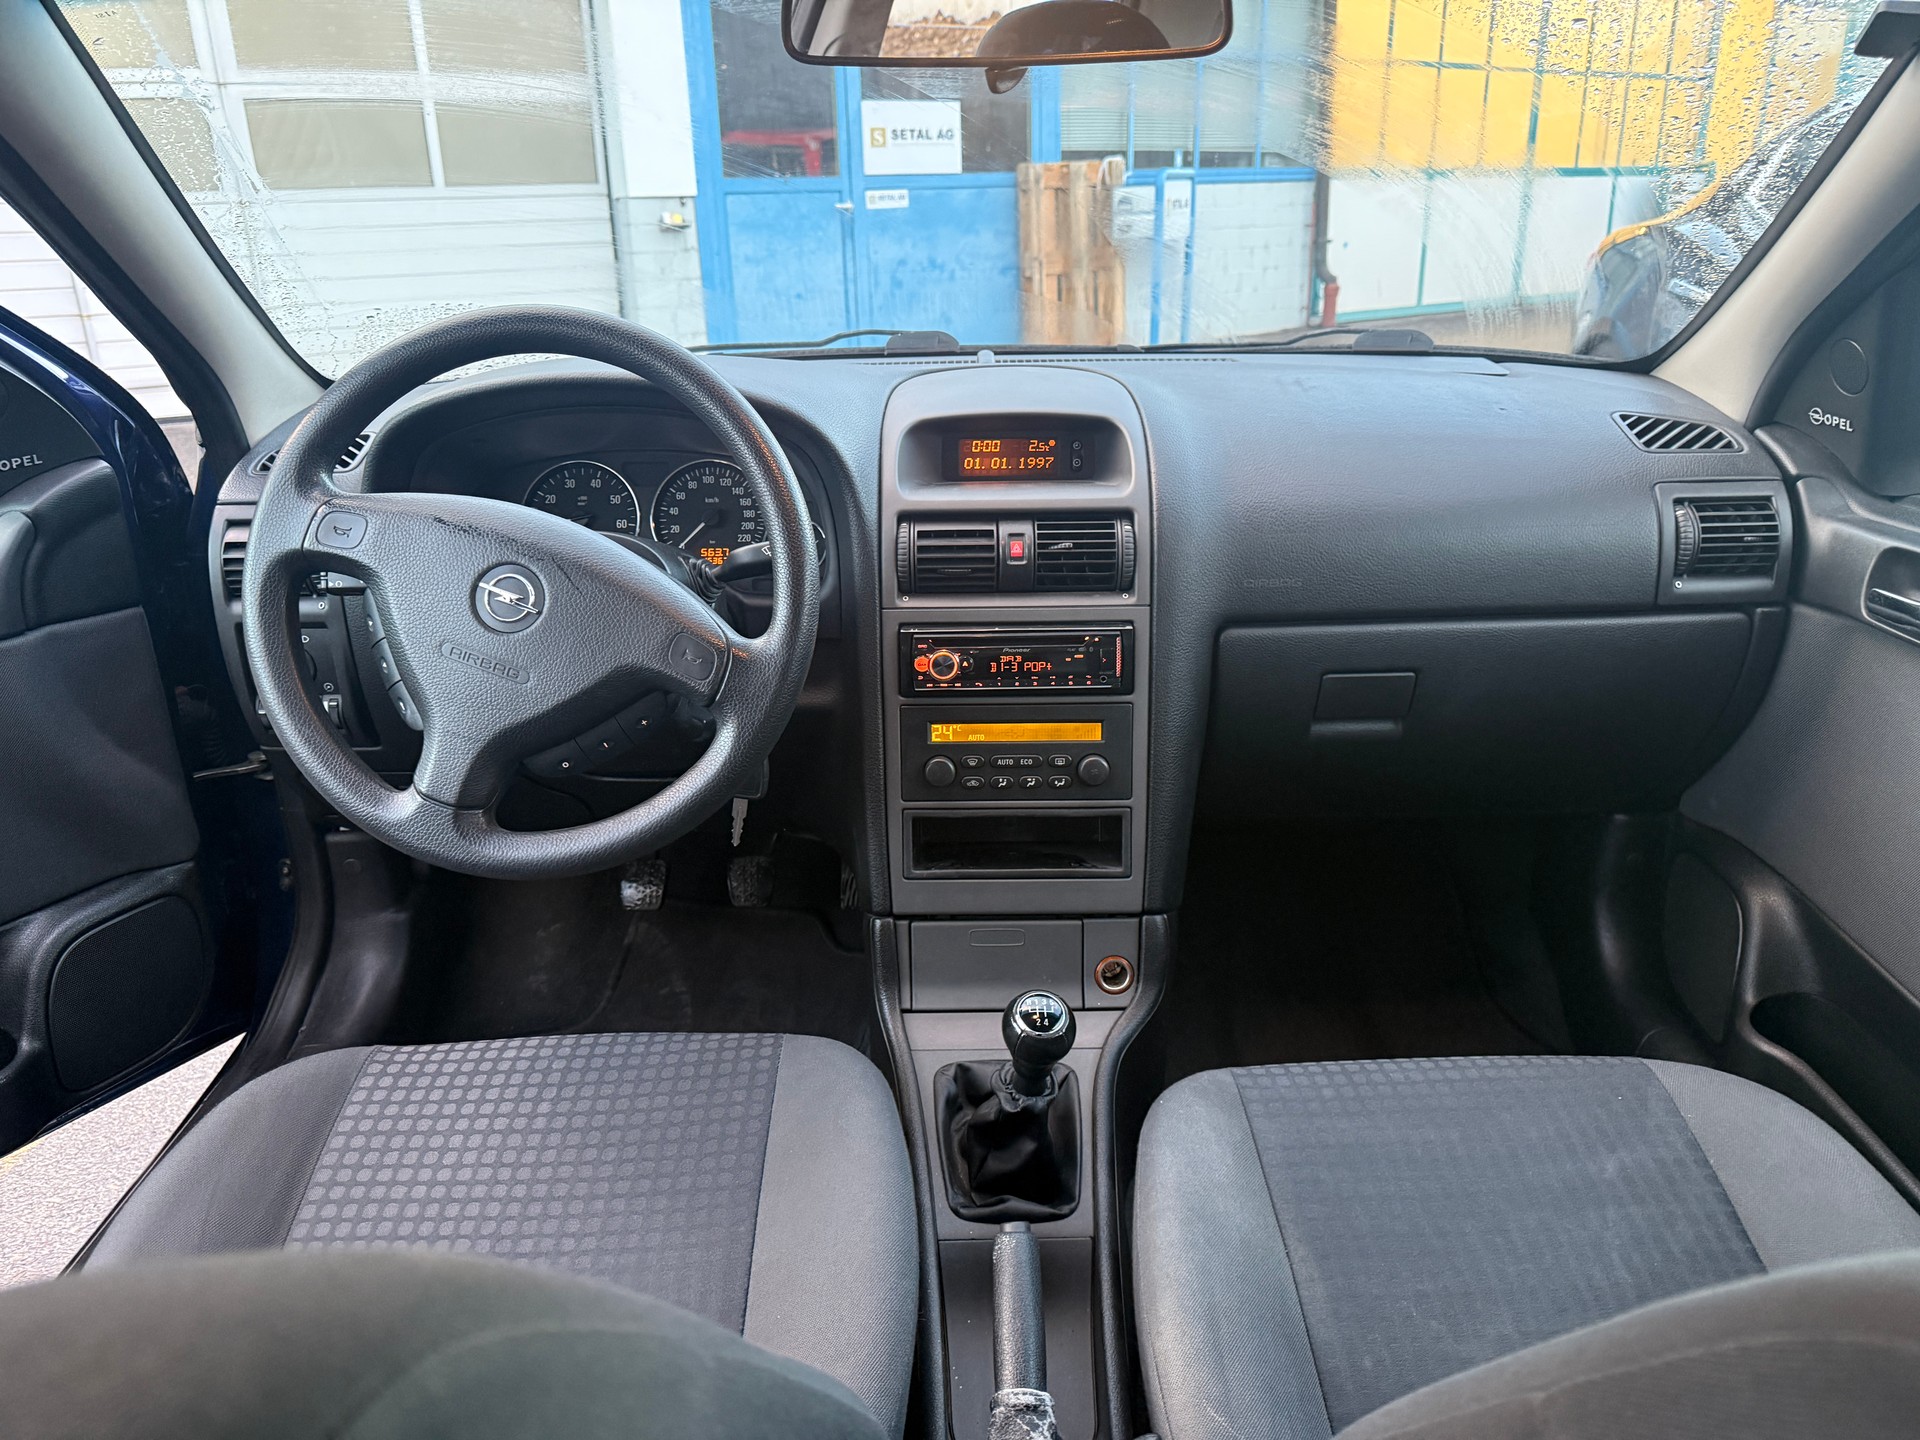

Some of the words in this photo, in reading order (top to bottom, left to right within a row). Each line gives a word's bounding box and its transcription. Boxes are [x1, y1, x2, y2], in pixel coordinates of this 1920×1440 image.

[891, 129, 932, 140] SETAL
[937, 129, 954, 140] AG
[1824, 414, 1853, 432] OPEL
[972, 440, 1001, 452] 0:00
[0, 454, 43, 471] OPEL
[1019, 457, 1054, 469] 1997
[565, 480, 576, 488] 30
[590, 480, 602, 488] 40
[702, 476, 715, 484] 100
[720, 478, 732, 487] 120
[688, 481, 697, 489] 80
[732, 487, 744, 495] 140
[545, 495, 556, 504] 20
[610, 495, 621, 504] 50
[676, 492, 686, 500] 60
[740, 498, 752, 506] 160
[669, 507, 679, 515] 40
[743, 510, 755, 518] 180
[616, 519, 628, 529] 60
[741, 522, 755, 530] 200
[670, 525, 680, 533] 20
[737, 534, 751, 542] 220
[449, 646, 520, 680] AIRBAG
[1000, 655, 1022, 663] DAB
[1023, 661, 1052, 672] POP+
[1035, 1018, 1042, 1026] 2
[1043, 1018, 1049, 1026] 4
